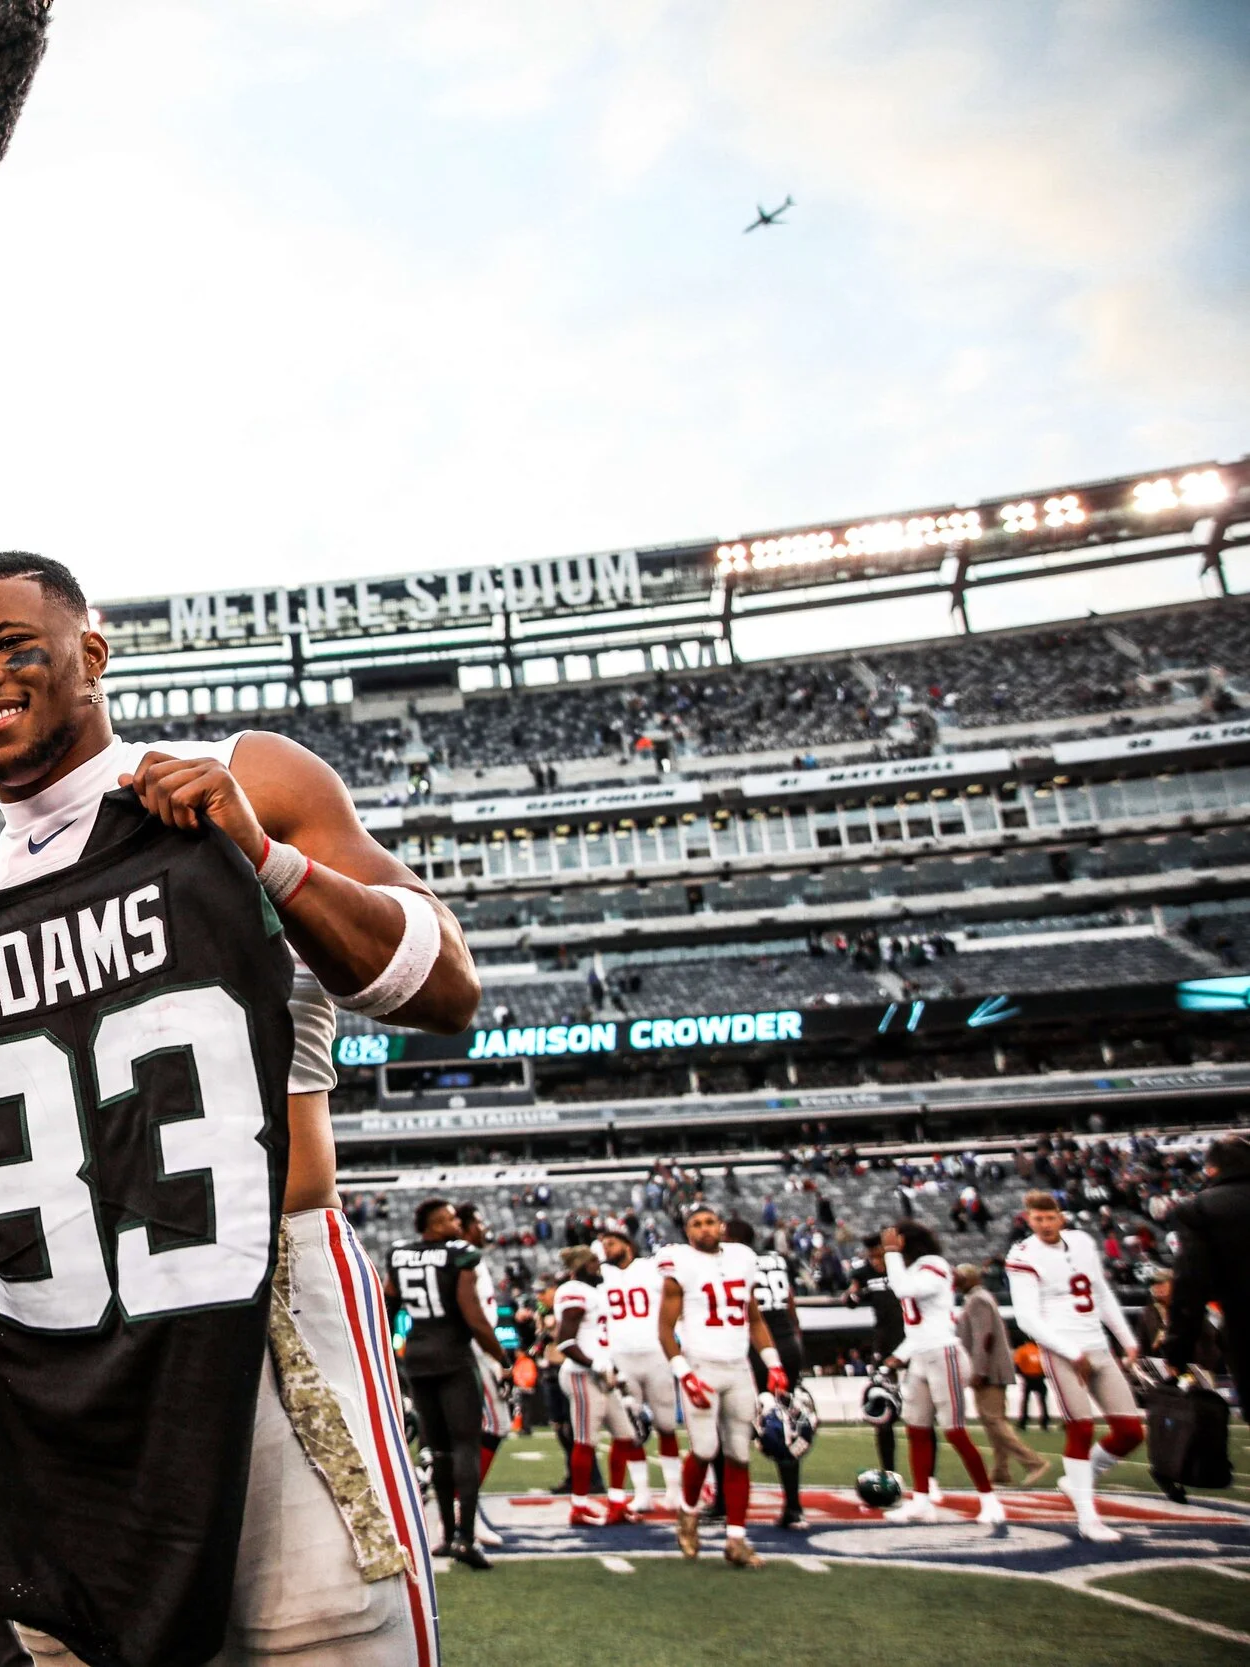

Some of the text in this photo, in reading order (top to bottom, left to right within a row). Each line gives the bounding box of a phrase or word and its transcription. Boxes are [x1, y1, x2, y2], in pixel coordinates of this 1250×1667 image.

[168, 549, 641, 642] METLIFE STADIUM
[338, 1034, 388, 1065] 82
[468, 1011, 802, 1059] JAMISON CROWDER
[398, 1265, 446, 1318] 51
[607, 1287, 649, 1320] 90
[701, 1279, 746, 1326] 15
[1070, 1273, 1094, 1313] 9
